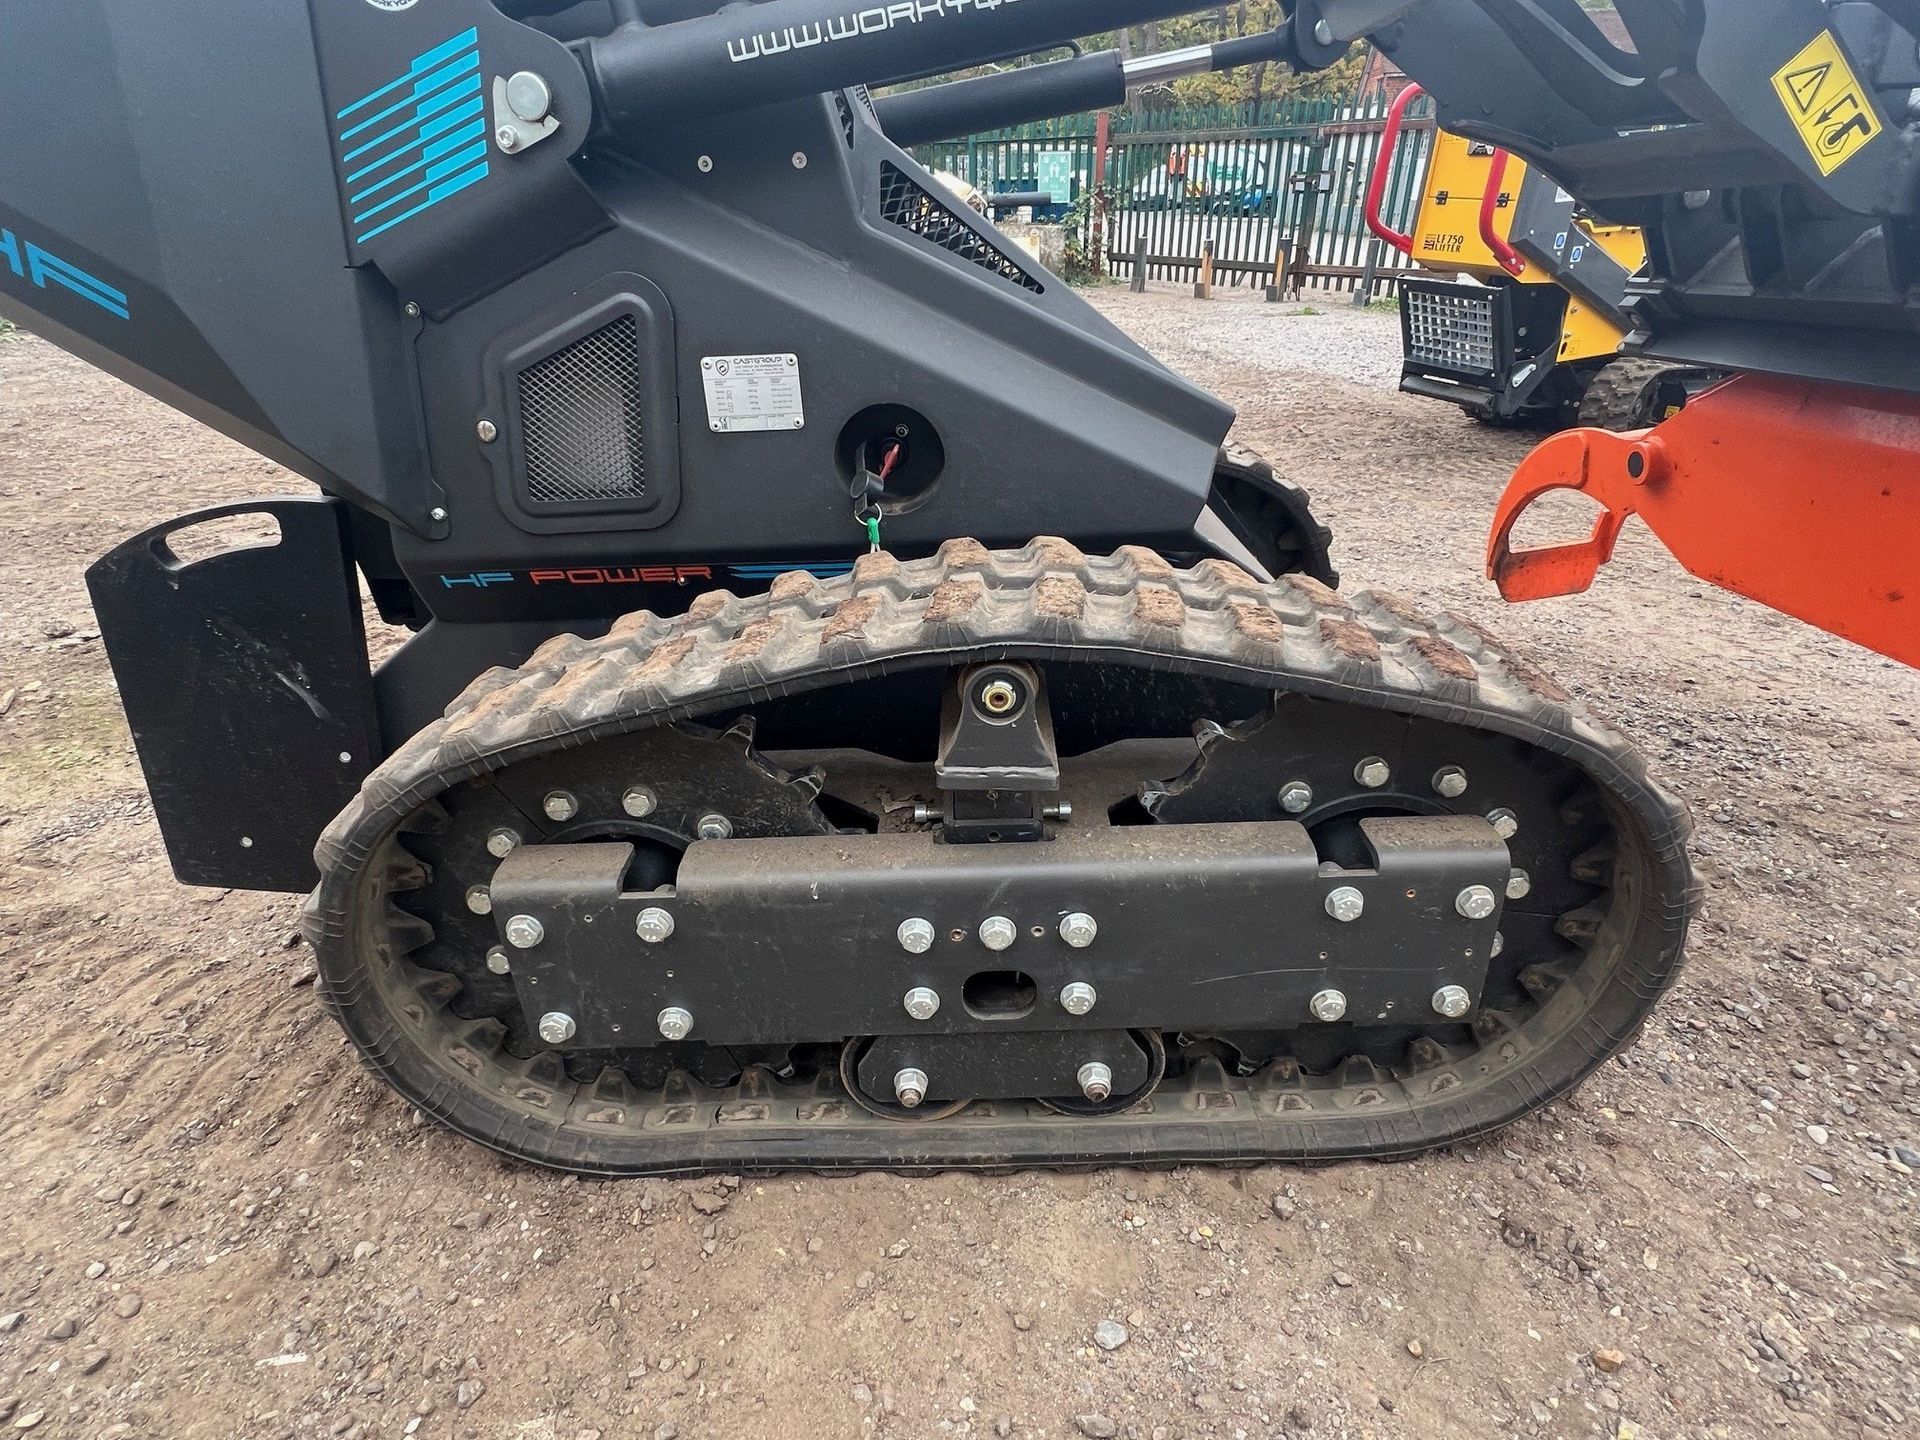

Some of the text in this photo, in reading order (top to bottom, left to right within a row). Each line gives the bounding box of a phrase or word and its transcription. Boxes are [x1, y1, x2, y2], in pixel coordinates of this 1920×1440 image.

[1447, 234, 1464, 245] 750
[1435, 243, 1461, 253] LIFTER
[440, 566, 712, 589] HF POWER
